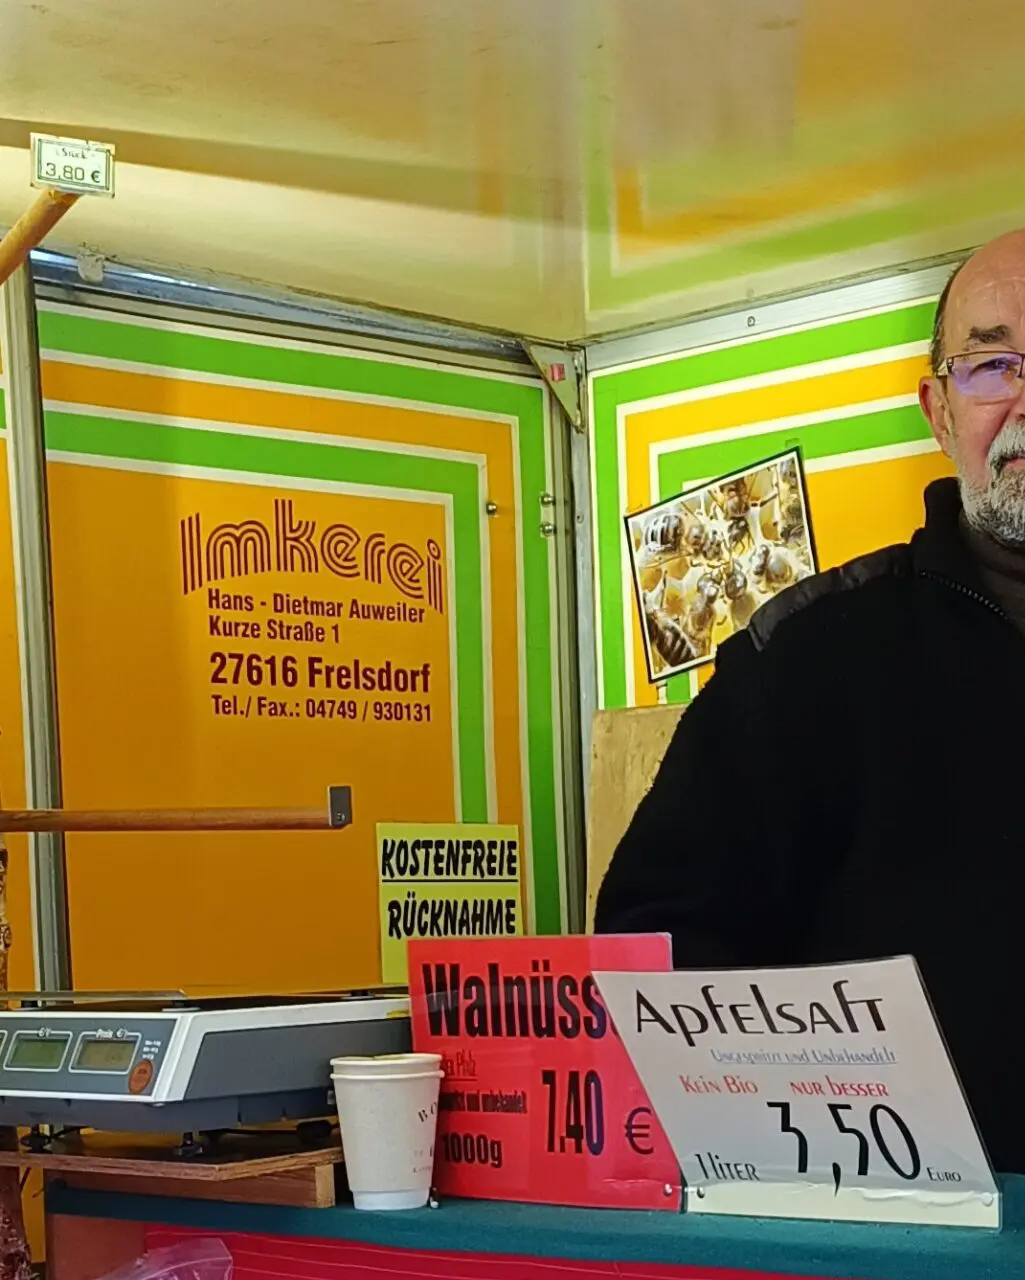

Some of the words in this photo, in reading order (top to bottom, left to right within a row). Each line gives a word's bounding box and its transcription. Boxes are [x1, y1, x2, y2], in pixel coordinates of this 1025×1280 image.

[45, 162, 85, 181] 3,80
[91, 170, 101, 183] €
[180, 498, 444, 615] Imkerei
[208, 588, 255, 612] Hans
[272, 592, 343, 619] Dietmar
[349, 597, 426, 624] Auweiler
[208, 616, 261, 641] Kurze
[265, 619, 326, 644] Straße
[331, 624, 340, 644] 1
[209, 652, 299, 688] 27616
[307, 655, 431, 694] Frelsdorf
[211, 694, 252, 720] Tel./
[257, 696, 301, 720] Fax.:
[306, 699, 358, 721] 04749
[373, 702, 432, 723] 930131
[381, 836, 519, 880] KOSTENFREIE
[387, 891, 517, 940] RÜCKNAHME
[421, 960, 622, 1039] Walnüss
[636, 979, 888, 1047] Apfelsaft
[786, 1048, 811, 1064] und
[812, 1045, 897, 1064] Unbehandelt
[722, 1074, 759, 1095] Bio
[441, 1132, 503, 1169] 1000g
[624, 1106, 655, 1156] €
[766, 1101, 922, 1198] 3,50
